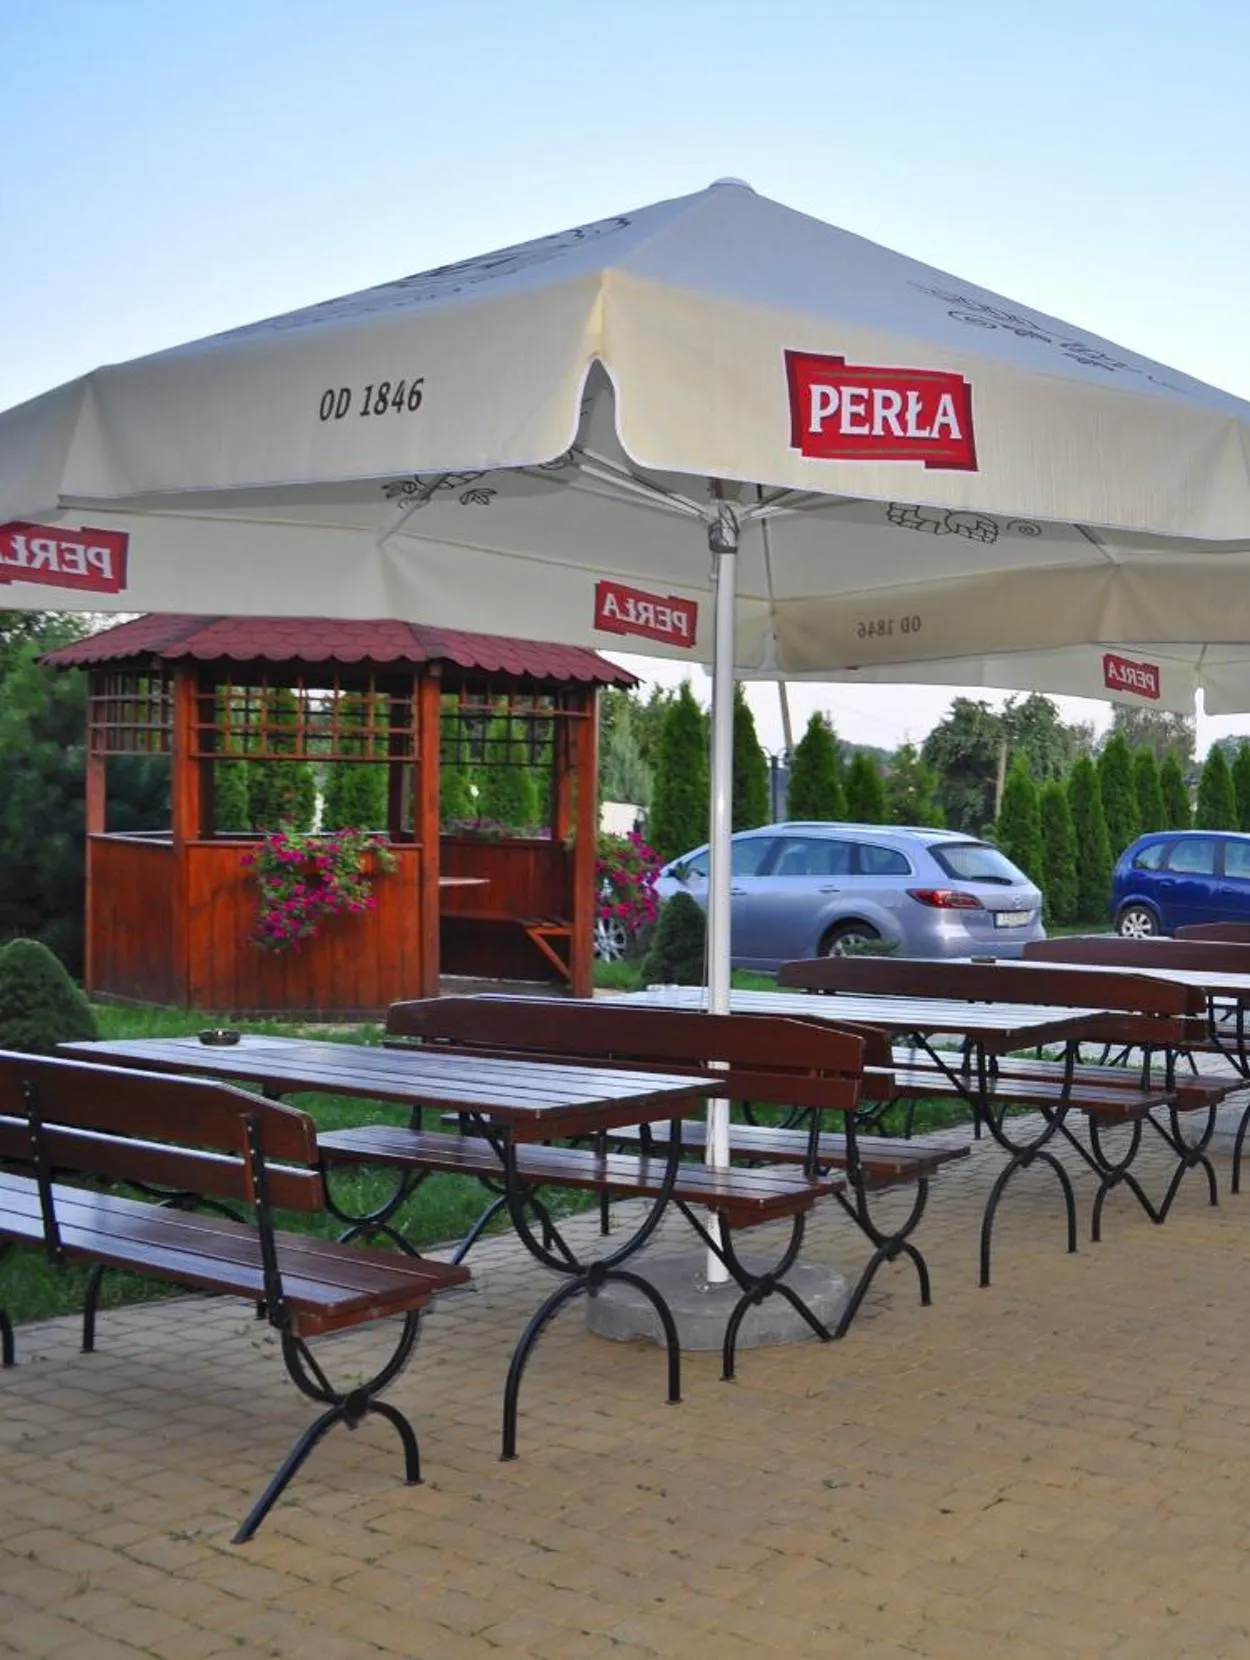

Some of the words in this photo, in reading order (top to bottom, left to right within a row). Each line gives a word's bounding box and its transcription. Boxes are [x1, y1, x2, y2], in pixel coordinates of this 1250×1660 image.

[319, 387, 352, 421] OD
[359, 376, 425, 417] 1846
[808, 383, 963, 440] PERŁA
